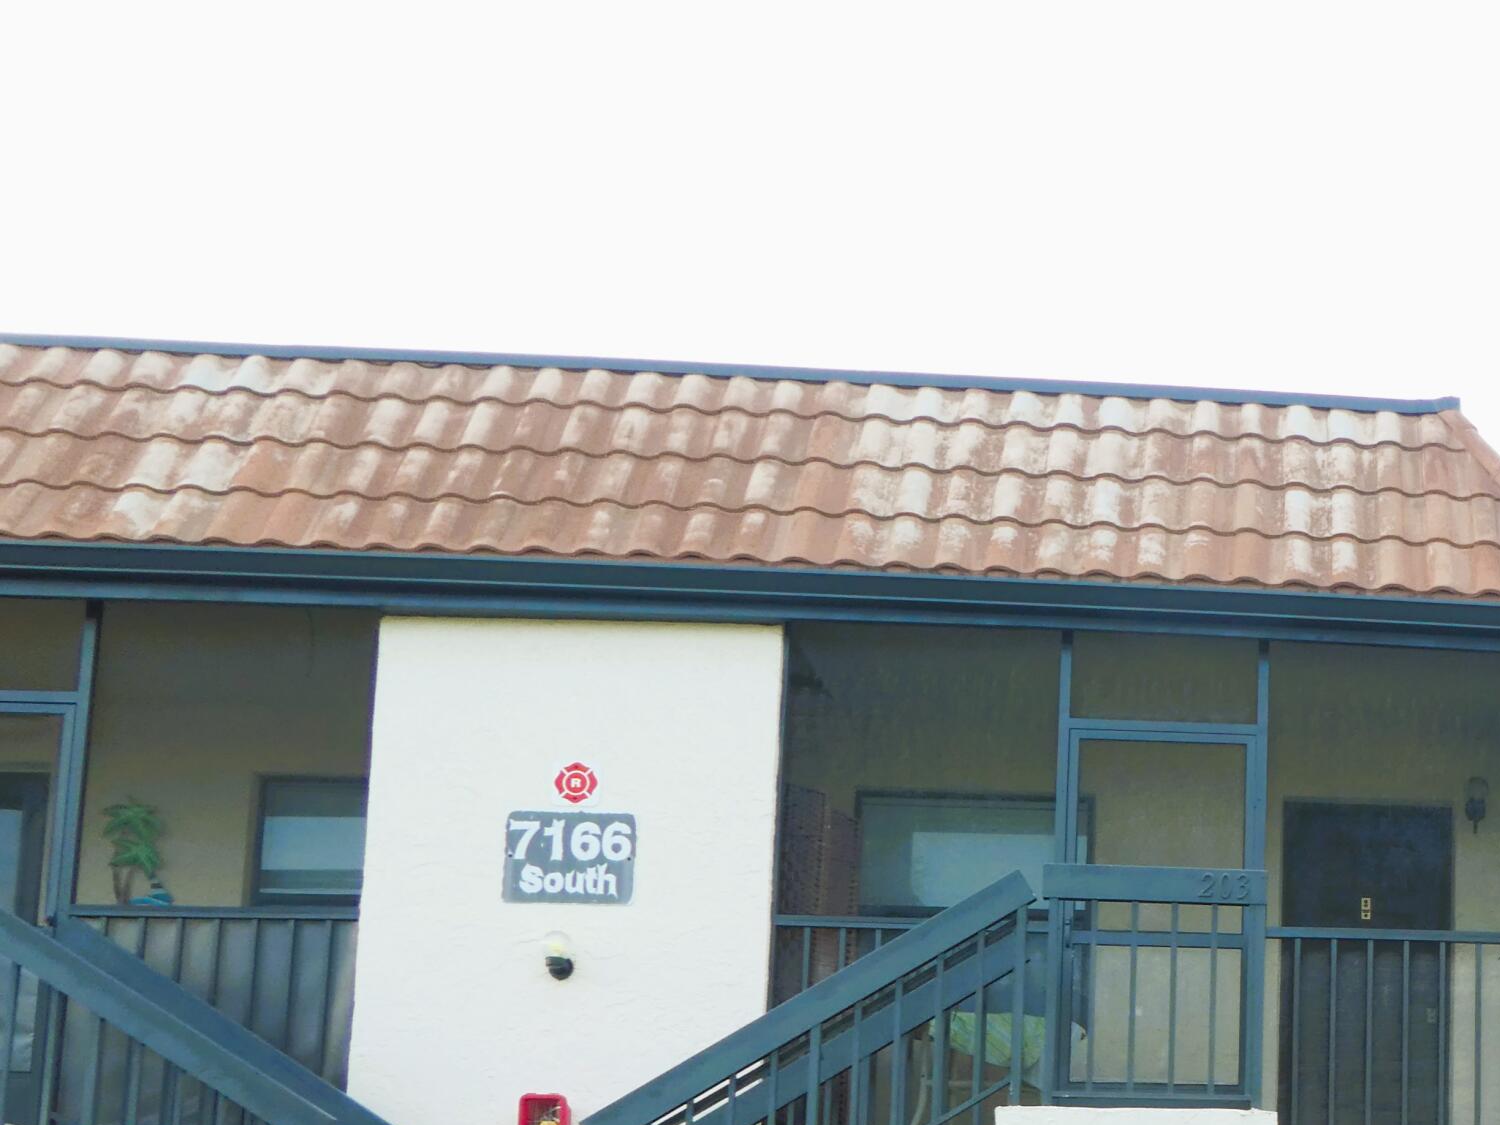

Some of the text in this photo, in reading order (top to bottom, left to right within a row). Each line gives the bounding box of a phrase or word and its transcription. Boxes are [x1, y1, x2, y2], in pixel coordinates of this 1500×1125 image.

[570, 778, 582, 788] R
[509, 819, 632, 862] 7166
[519, 863, 618, 898] South
[1198, 872, 1249, 900] 203
